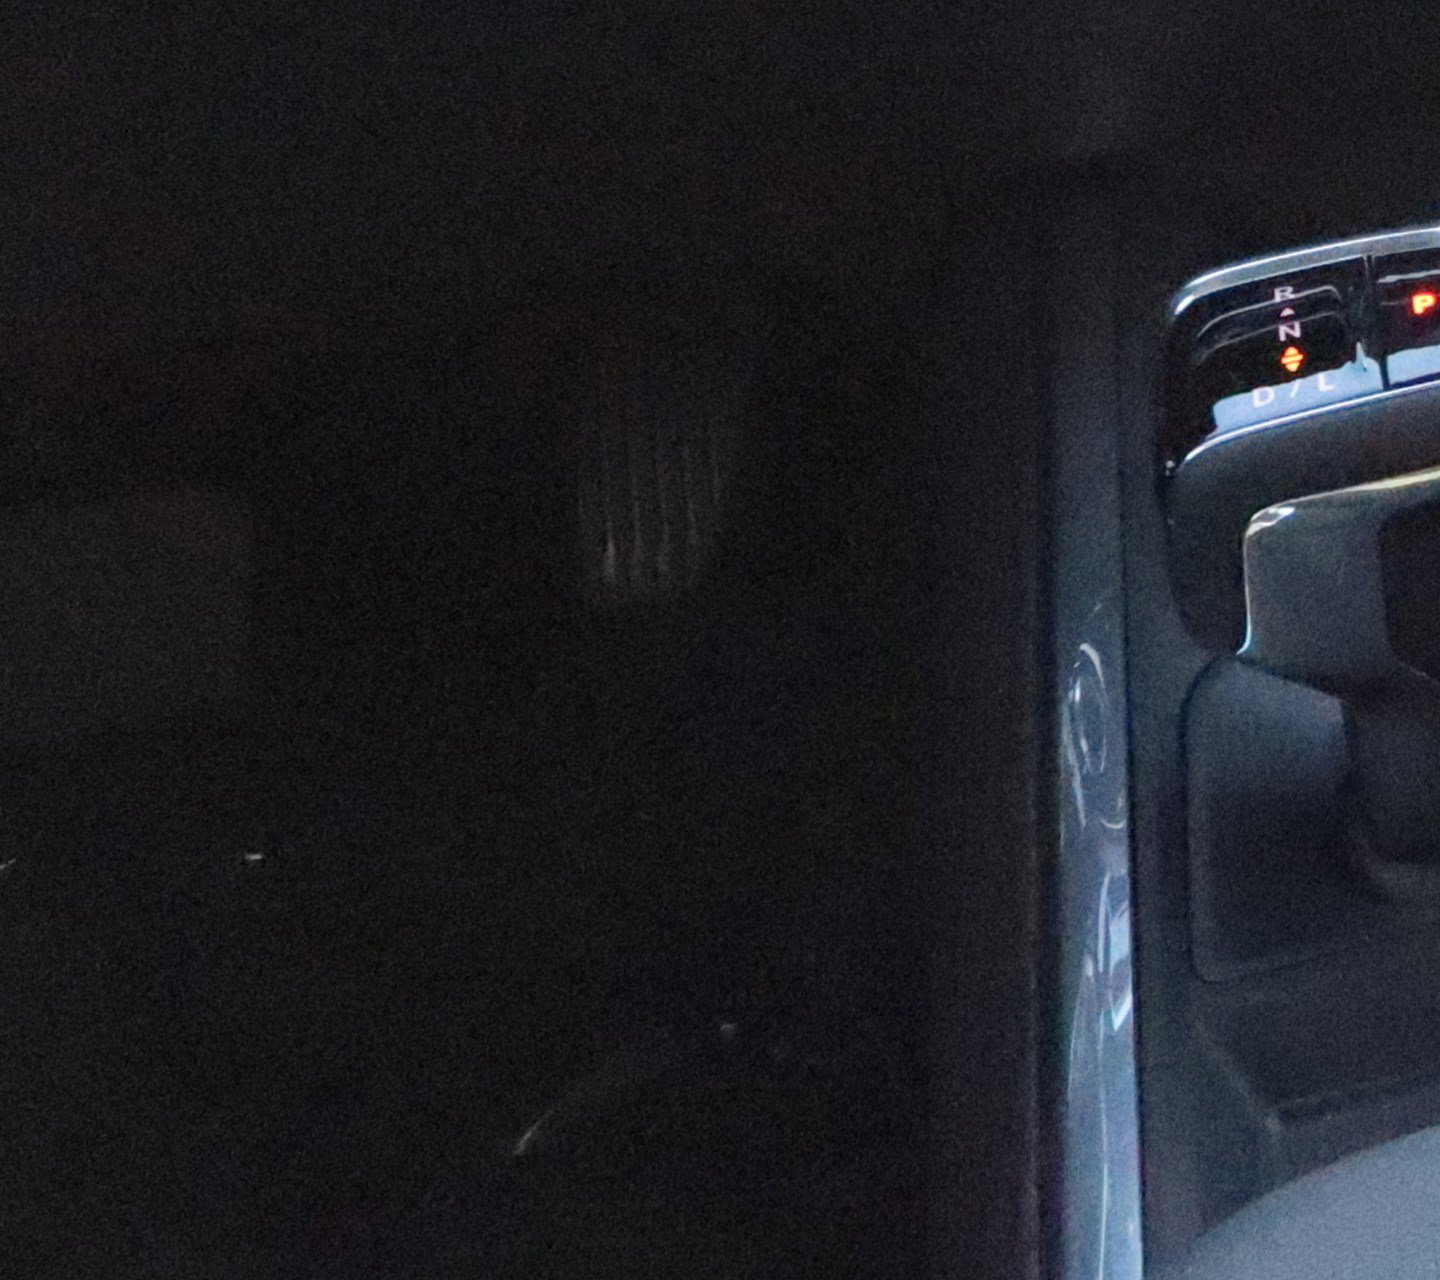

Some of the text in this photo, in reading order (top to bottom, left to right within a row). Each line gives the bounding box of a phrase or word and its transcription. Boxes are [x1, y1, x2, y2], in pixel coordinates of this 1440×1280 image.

[1274, 286, 1295, 302] R
[1412, 294, 1436, 314] P
[1278, 322, 1300, 342] N
[1253, 388, 1275, 407] D
[1317, 373, 1334, 392] L
